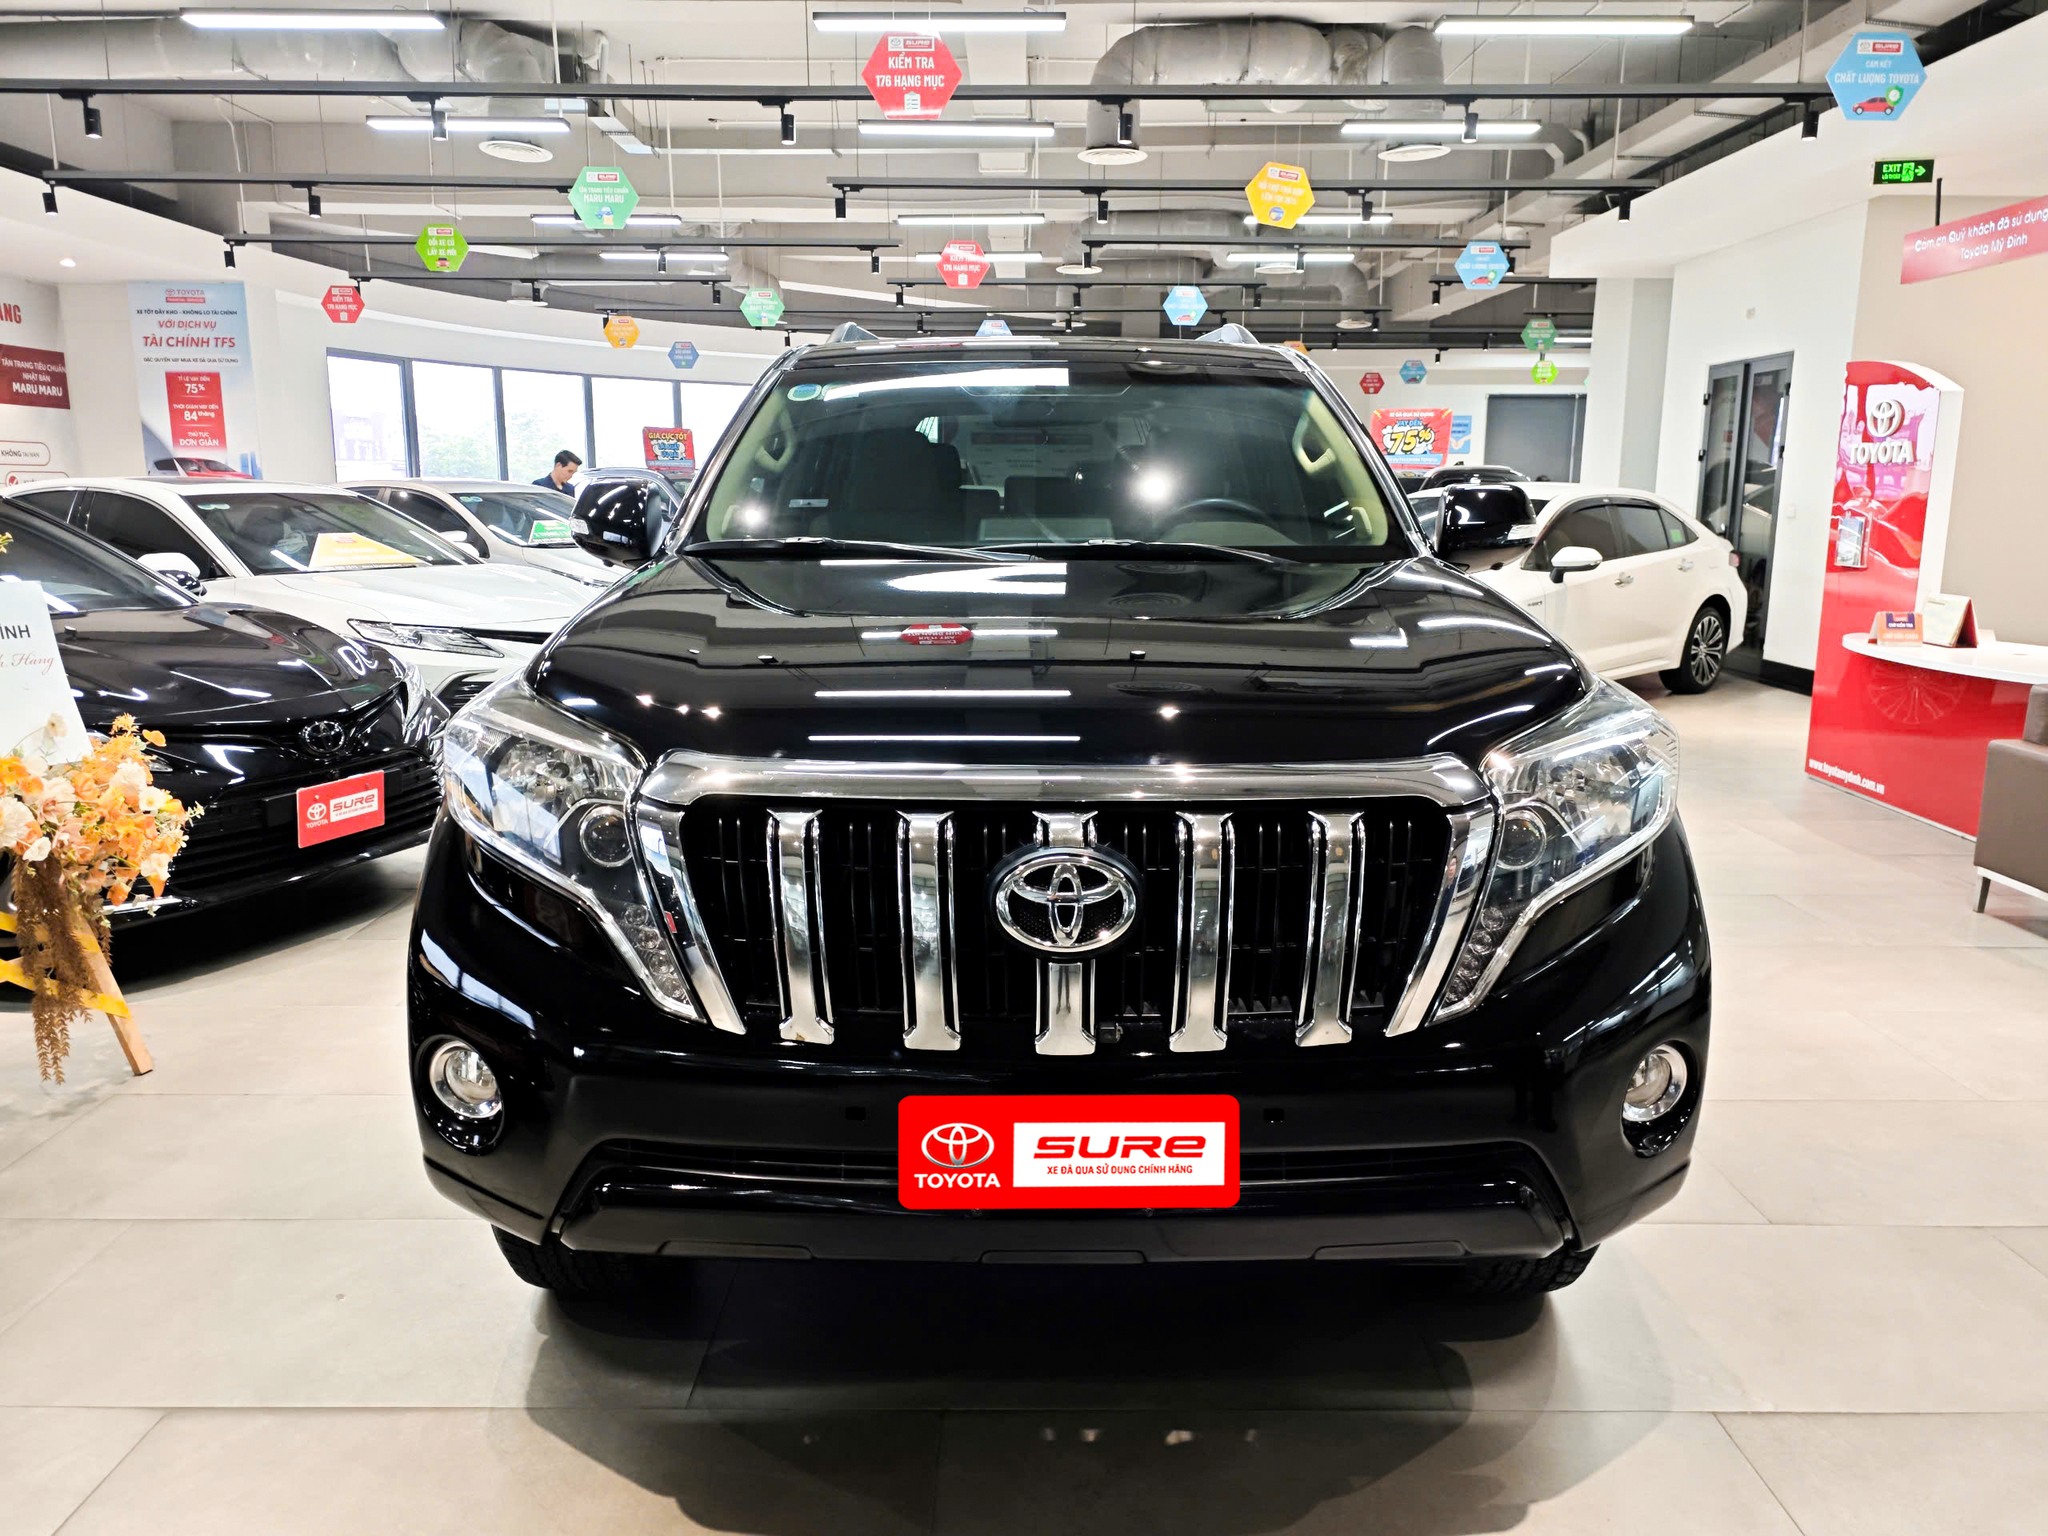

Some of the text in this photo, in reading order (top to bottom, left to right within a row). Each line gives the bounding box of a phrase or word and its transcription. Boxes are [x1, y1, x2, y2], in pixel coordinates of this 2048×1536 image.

[888, 52, 935, 69] KIỂM TRA
[875, 75, 945, 90] 176 HẠNG MỤC
[1834, 70, 1919, 86] CHẤT LƯỢNG TOYOTA
[1882, 163, 1902, 173] EXIT
[584, 194, 624, 203] MARU MARU
[1967, 220, 1995, 238] khách
[1997, 216, 2010, 231] đã
[1960, 244, 1989, 260] Toyota
[2007, 234, 2028, 249] Đình
[158, 319, 217, 331] VỚI DỊCH VỤ
[143, 333, 236, 348] TÀI CHÍNH TFS
[14, 359, 34, 370] TRANG
[12, 381, 63, 397] MARU MARU
[184, 383, 205, 394] 75%
[184, 410, 198, 421] 84
[179, 436, 219, 446] ĐƠN GIẢN
[675, 431, 687, 441] TỐT
[1388, 428, 1432, 455] 75%
[1850, 439, 1914, 464] TOYOTA
[306, 818, 329, 829] TOYOTA
